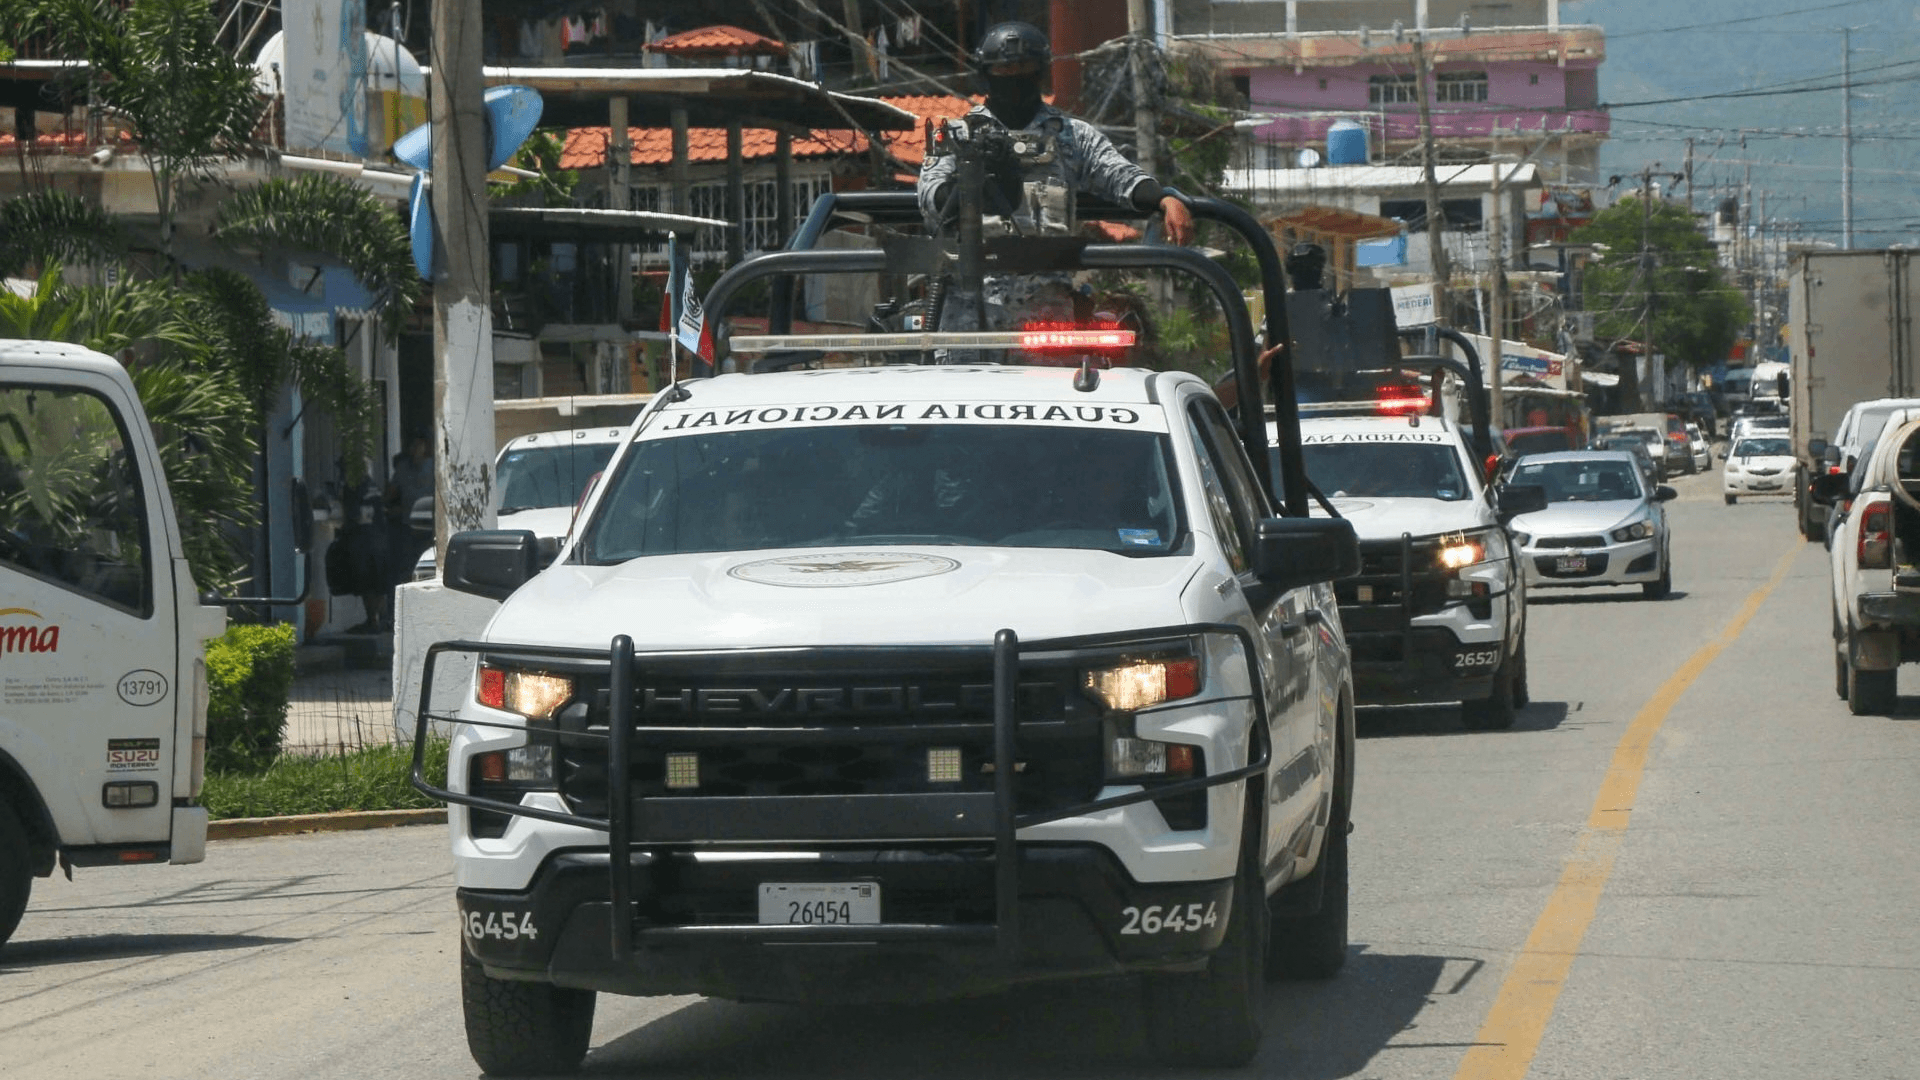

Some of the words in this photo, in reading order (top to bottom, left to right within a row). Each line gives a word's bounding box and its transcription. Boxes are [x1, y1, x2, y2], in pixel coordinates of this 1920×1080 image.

[1454, 649, 1498, 668] 26521
[122, 680, 162, 696] 13791
[106, 750, 160, 763] ISUZU
[788, 900, 851, 924] 26454
[1119, 900, 1218, 935] 26454
[461, 909, 539, 940] 26454
